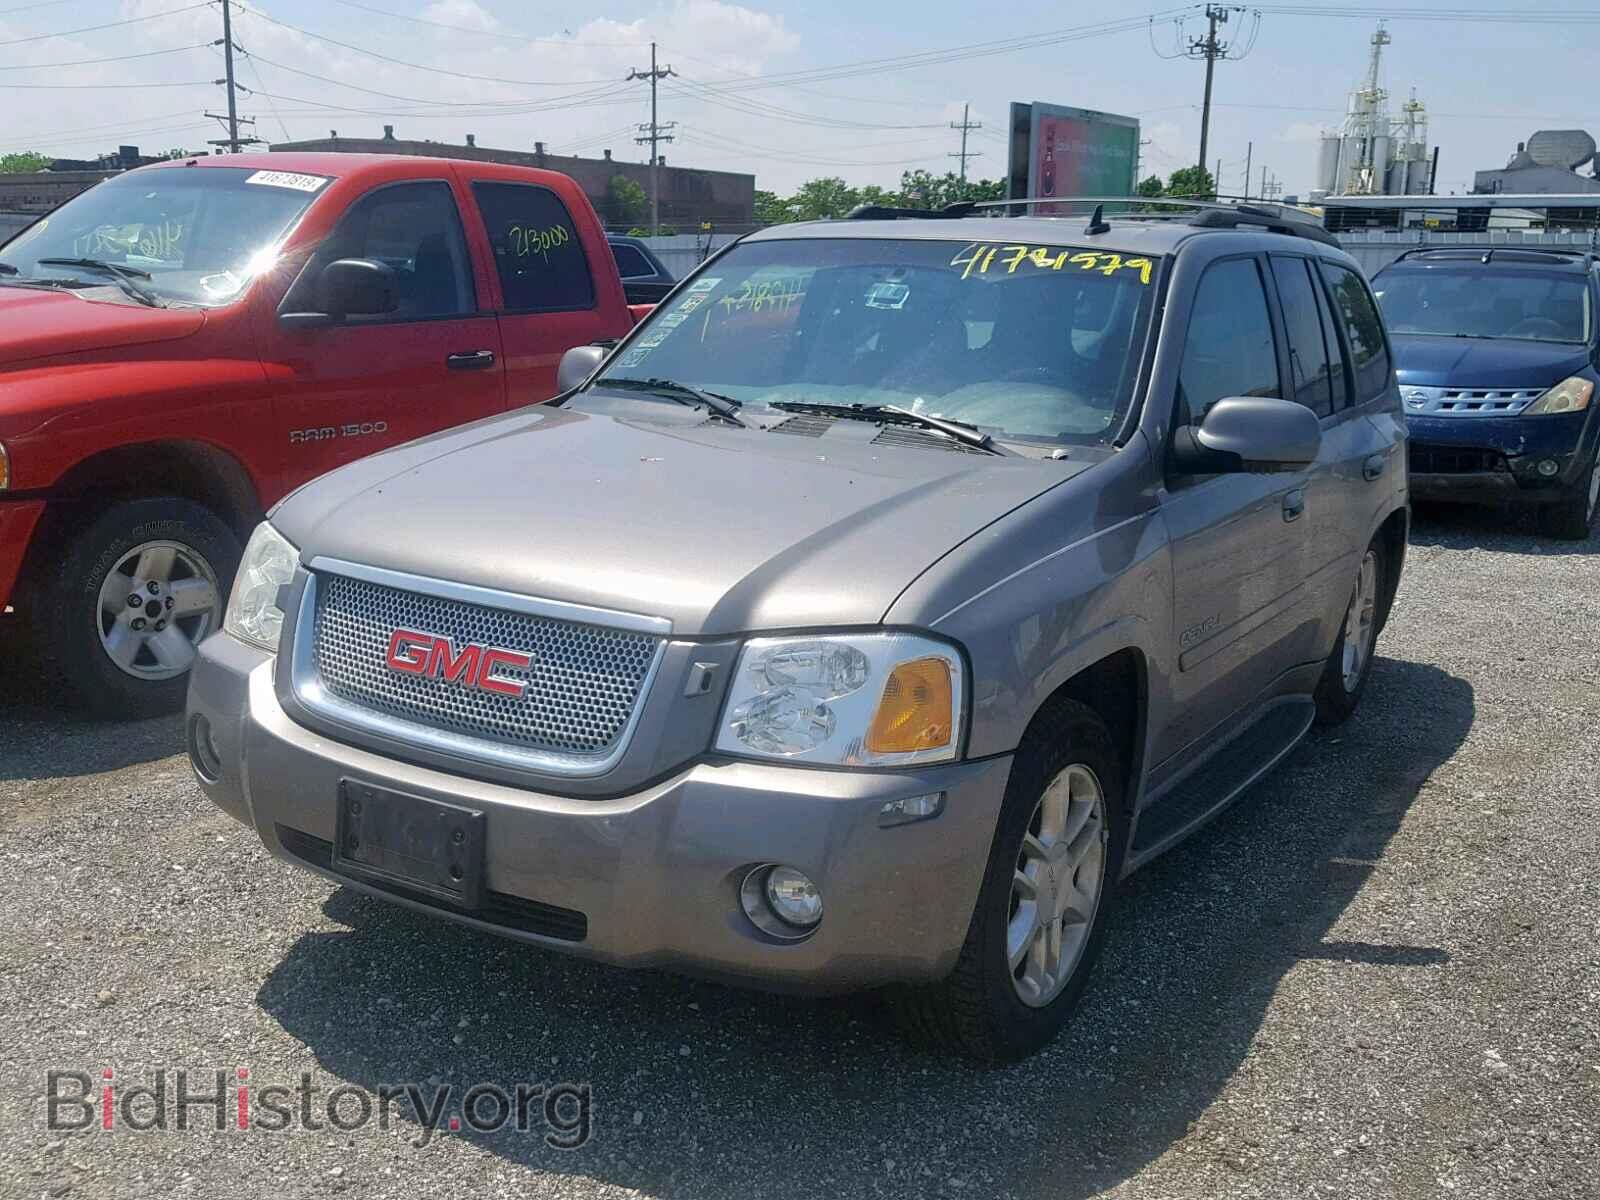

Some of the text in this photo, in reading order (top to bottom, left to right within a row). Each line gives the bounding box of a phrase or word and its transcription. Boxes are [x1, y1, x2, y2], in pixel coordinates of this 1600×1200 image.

[289, 421, 388, 443] RAM 1500
[387, 626, 536, 698] GMC
